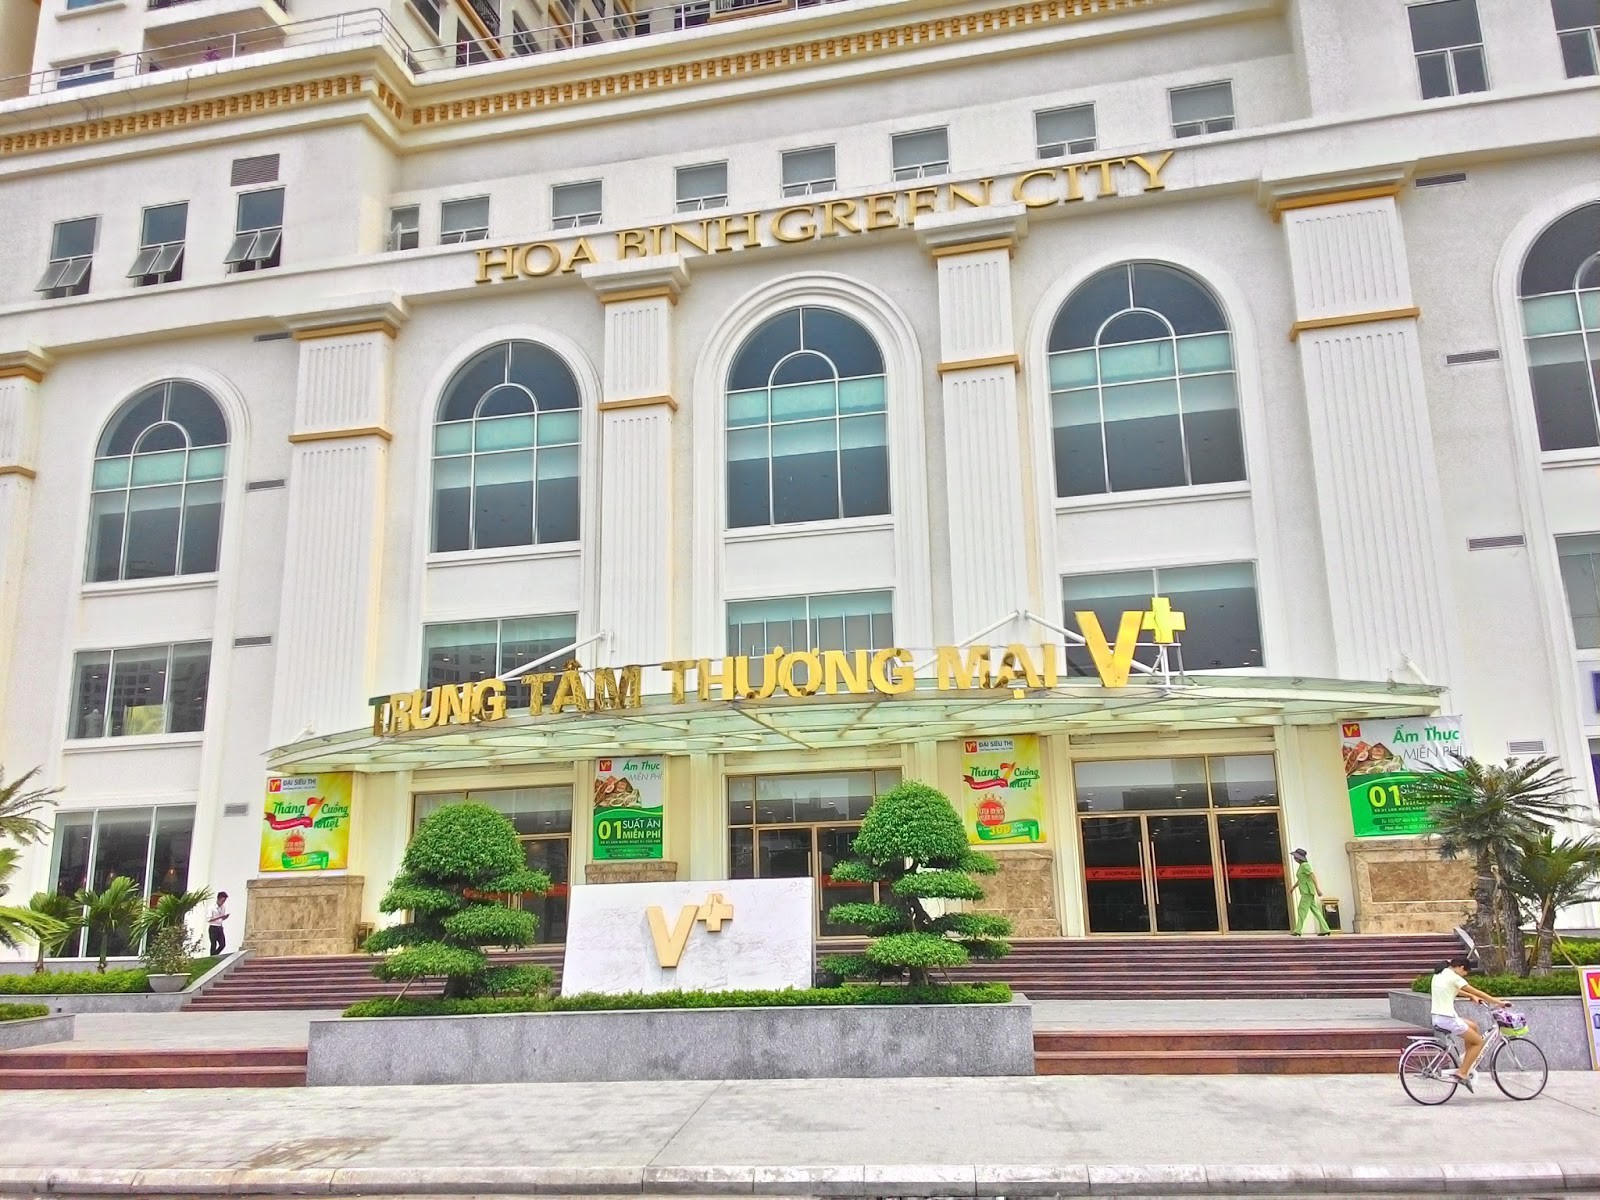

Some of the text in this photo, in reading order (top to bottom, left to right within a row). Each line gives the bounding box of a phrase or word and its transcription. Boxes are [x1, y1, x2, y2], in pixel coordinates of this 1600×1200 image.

[475, 150, 1175, 283] HOA BINH GREEN CITY
[368, 678, 507, 737] TRUNG
[521, 659, 642, 717] TÂM
[661, 645, 915, 705] THƯƠNG
[936, 643, 1058, 700] MẠI
[1424, 726, 1460, 744] Thực
[1000, 762, 1016, 780] 7
[1368, 784, 1401, 808] 01
[307, 796, 325, 819] 7
[597, 820, 622, 840] 01
[622, 817, 644, 829] SUẤT
